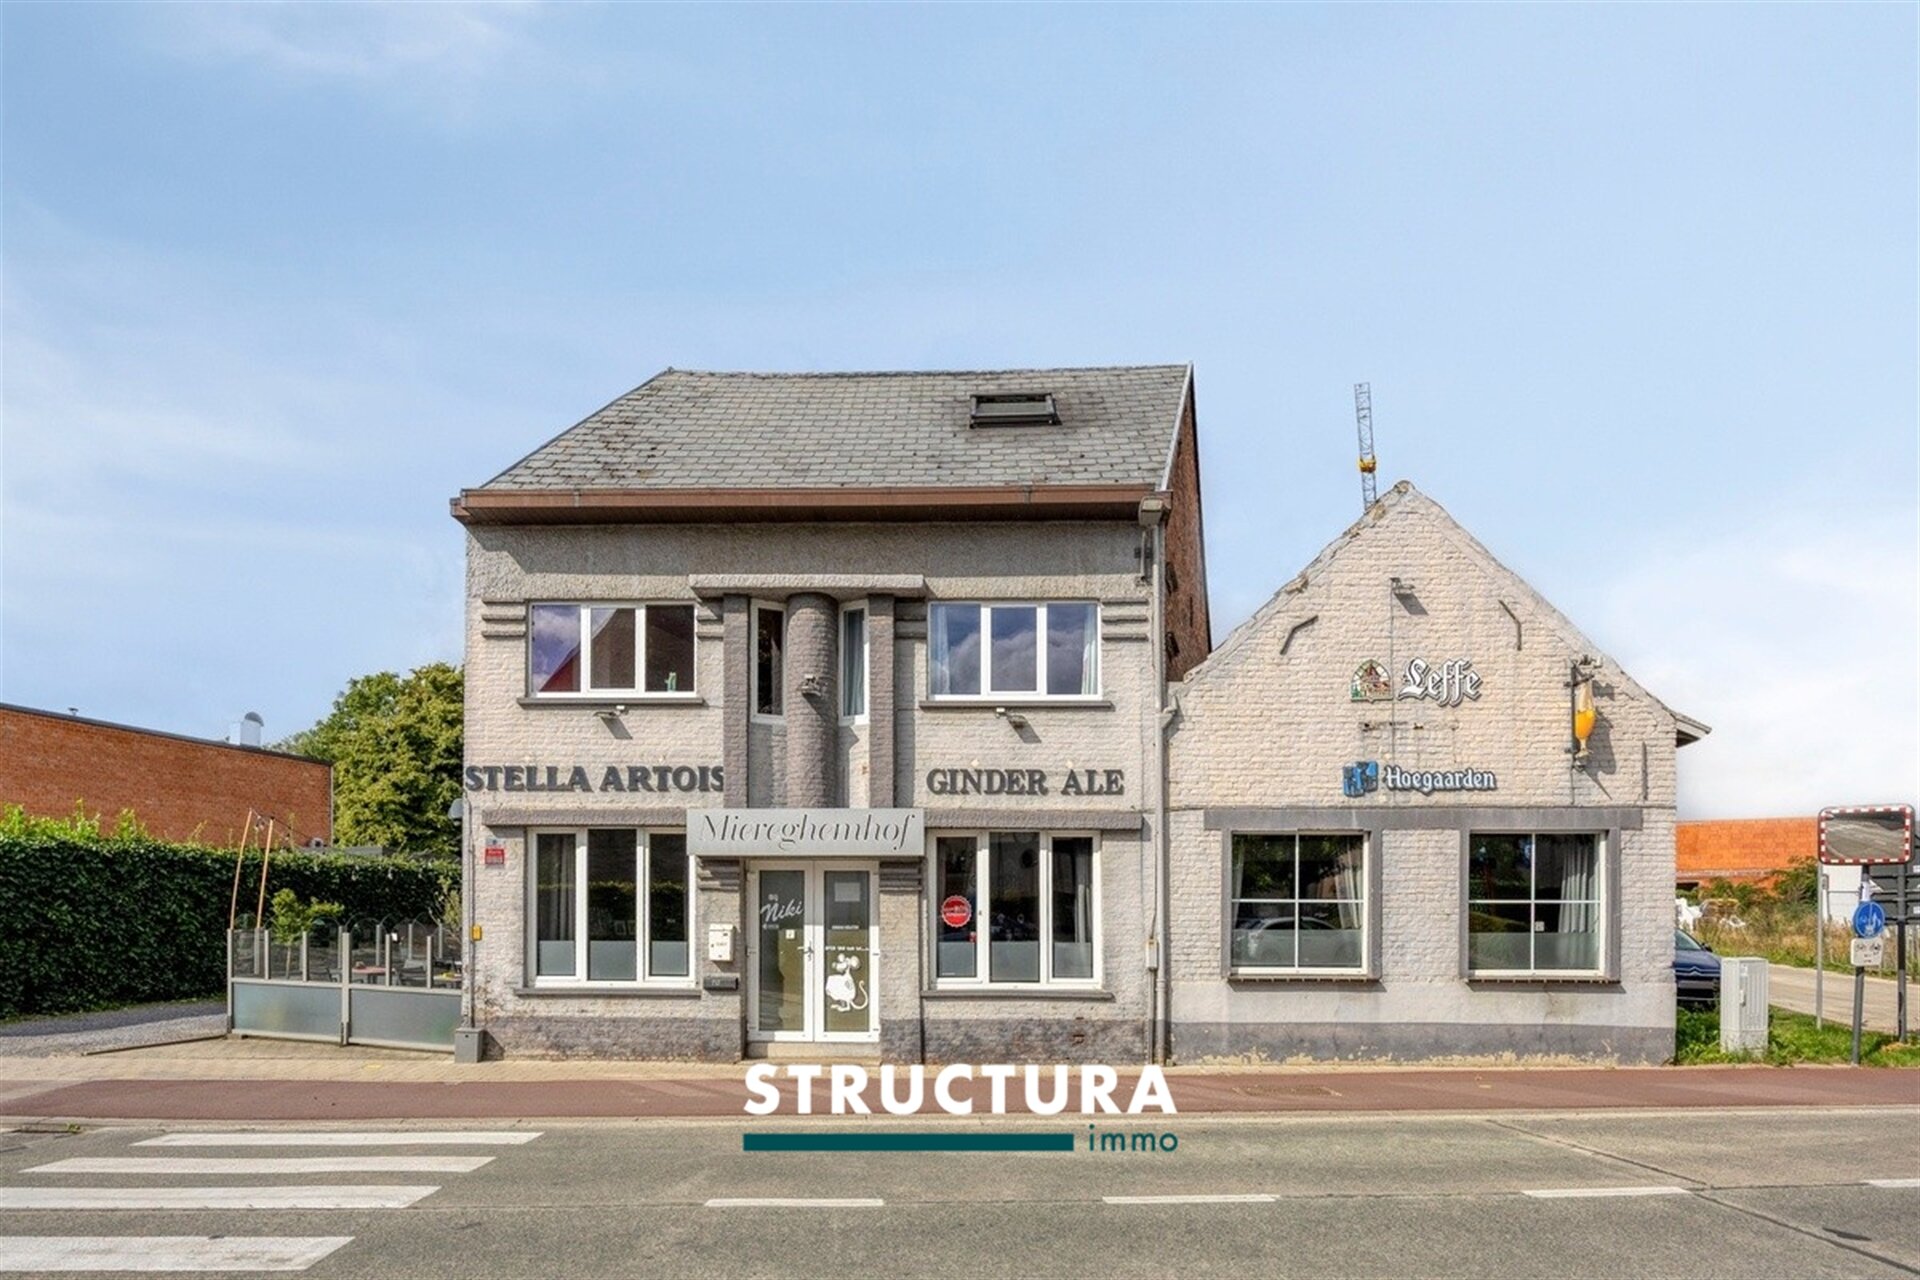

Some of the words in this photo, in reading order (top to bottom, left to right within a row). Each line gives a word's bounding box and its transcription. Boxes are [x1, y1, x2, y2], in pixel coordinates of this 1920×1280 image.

[1398, 656, 1483, 707] Leffe
[465, 765, 594, 792] STELLA
[600, 765, 724, 792] ARTOIS
[926, 768, 1049, 796] GINDER
[1060, 769, 1125, 796] ALE
[1384, 765, 1497, 796] Hoegaarden
[701, 813, 916, 851] Miereghemhof
[760, 898, 804, 922] Niki
